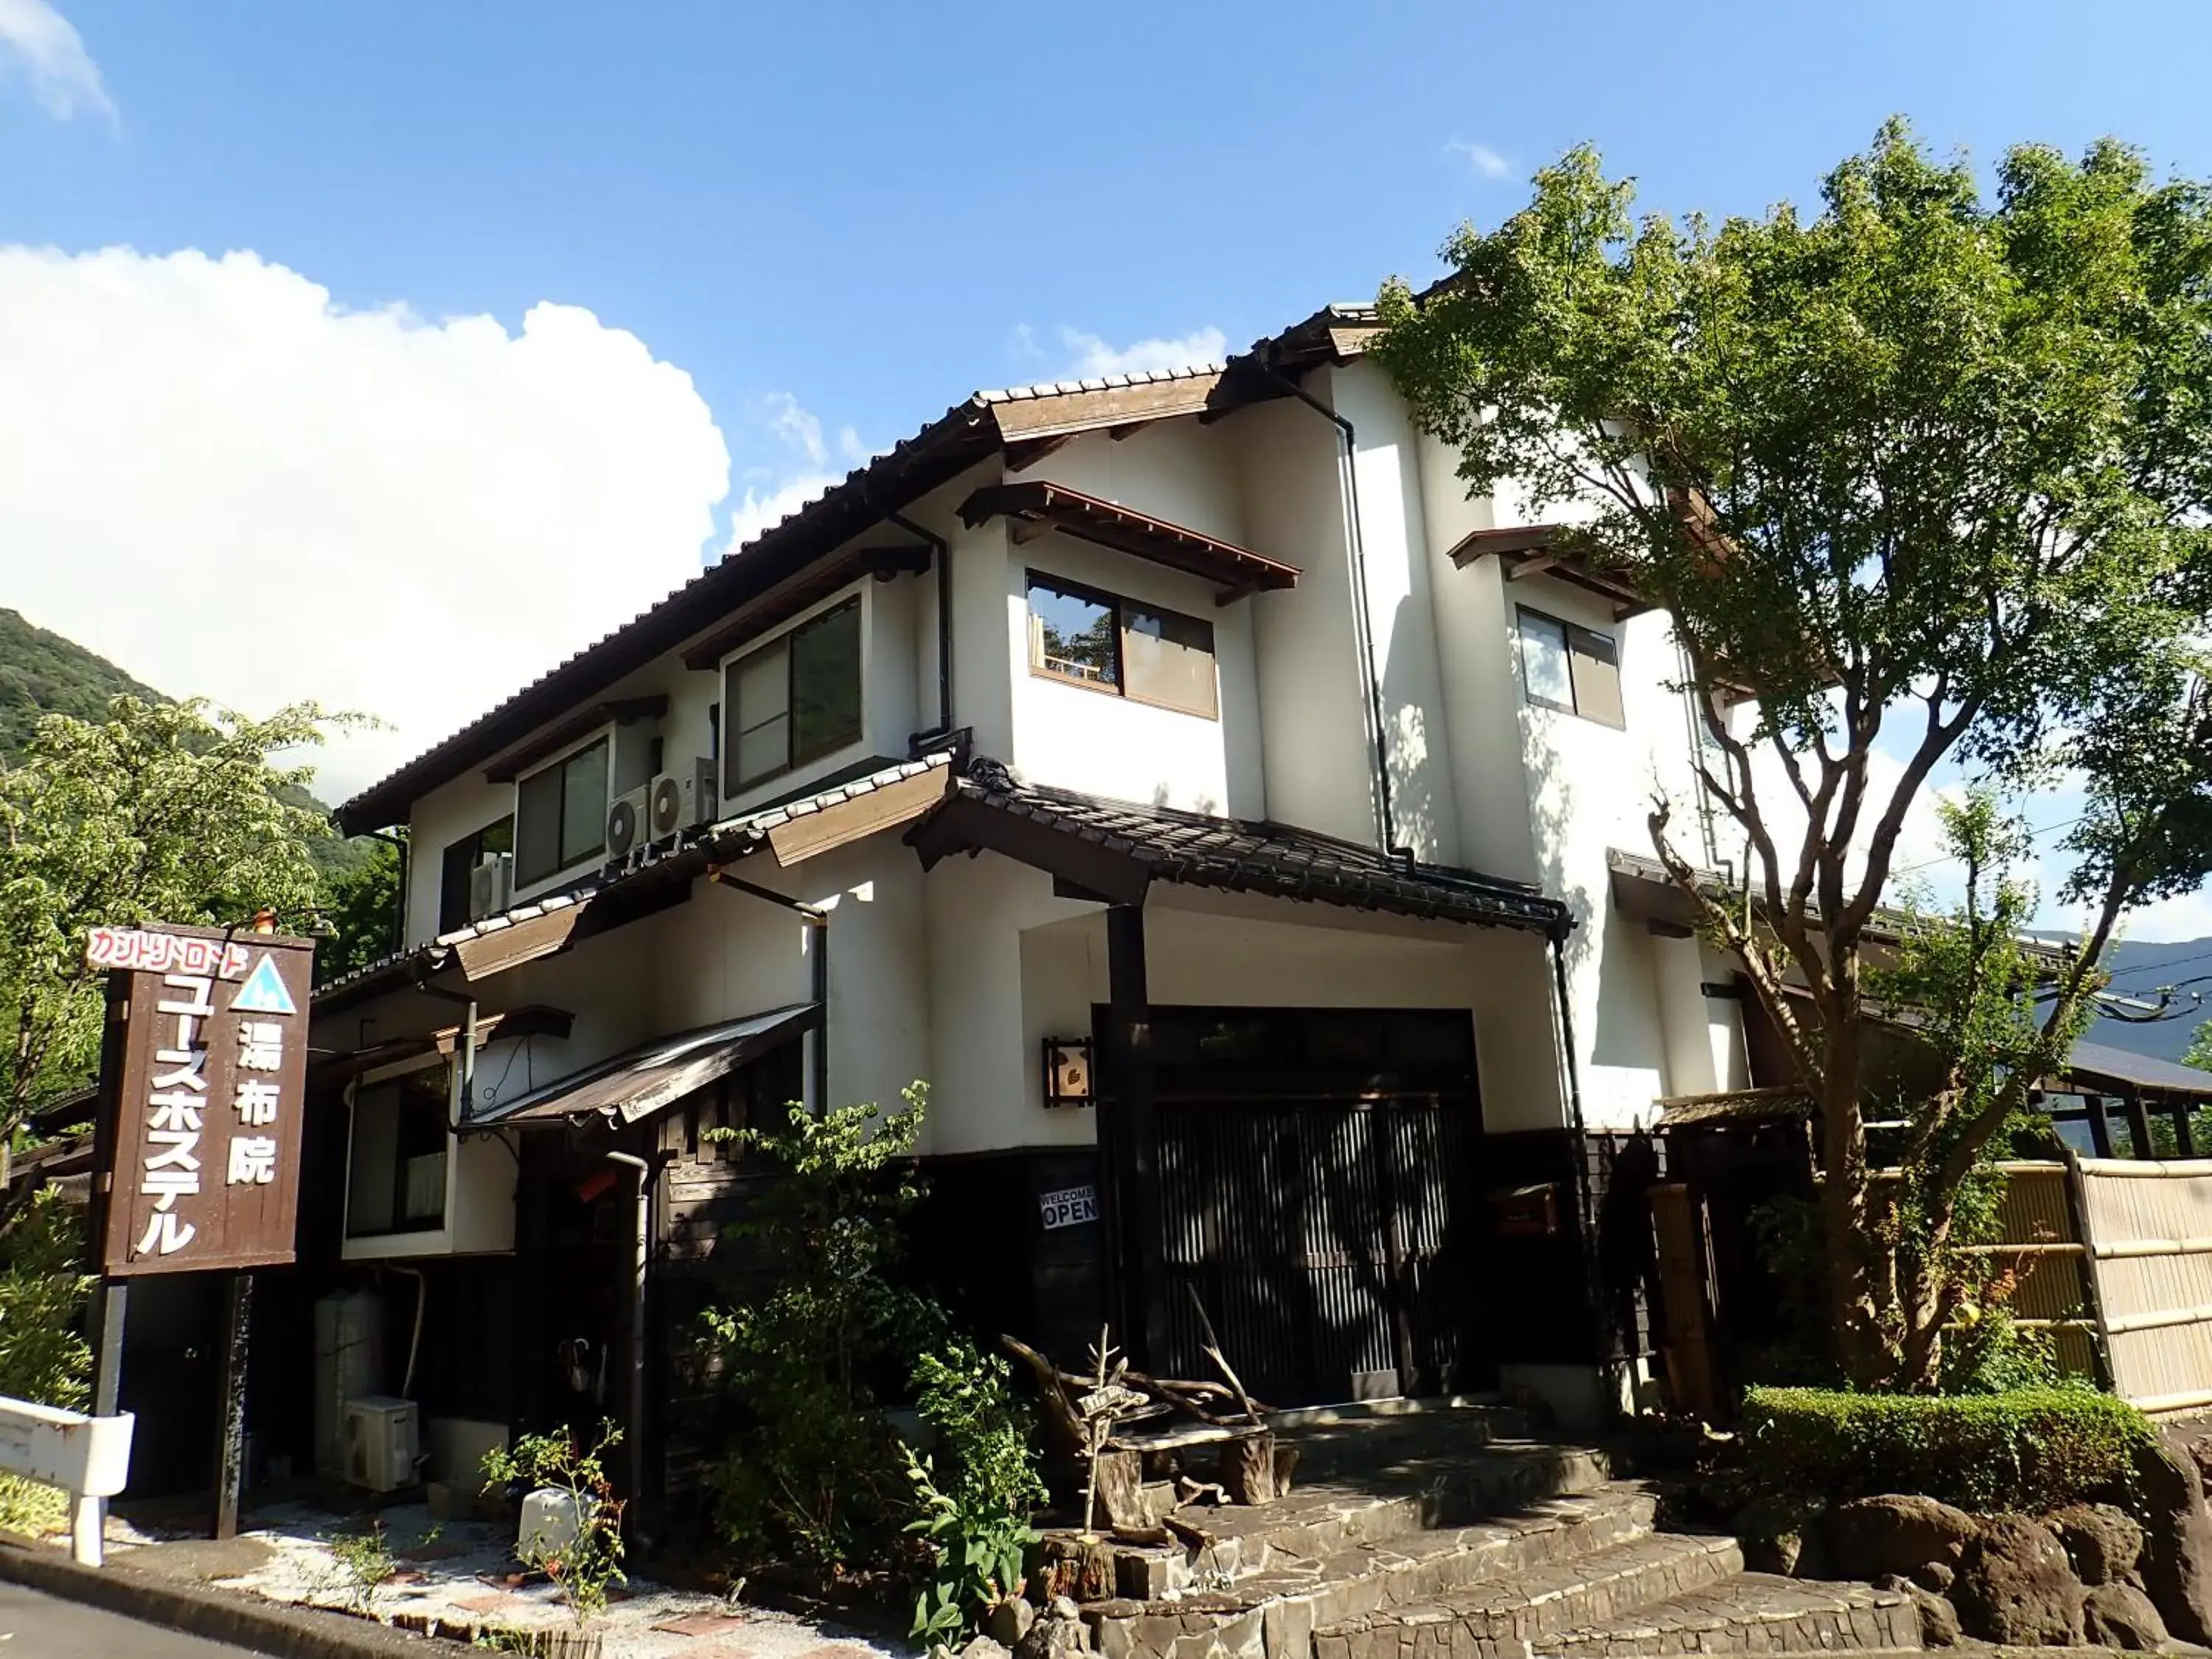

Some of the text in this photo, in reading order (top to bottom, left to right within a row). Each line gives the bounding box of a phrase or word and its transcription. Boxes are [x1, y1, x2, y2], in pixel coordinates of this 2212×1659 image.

[88, 928, 249, 978] カントリーロード
[136, 974, 215, 1255] ユースホステル
[227, 1022, 282, 1185] 湯布院
[1040, 1187, 1095, 1205] WELCOME
[1044, 1200, 1097, 1225] OPEN
